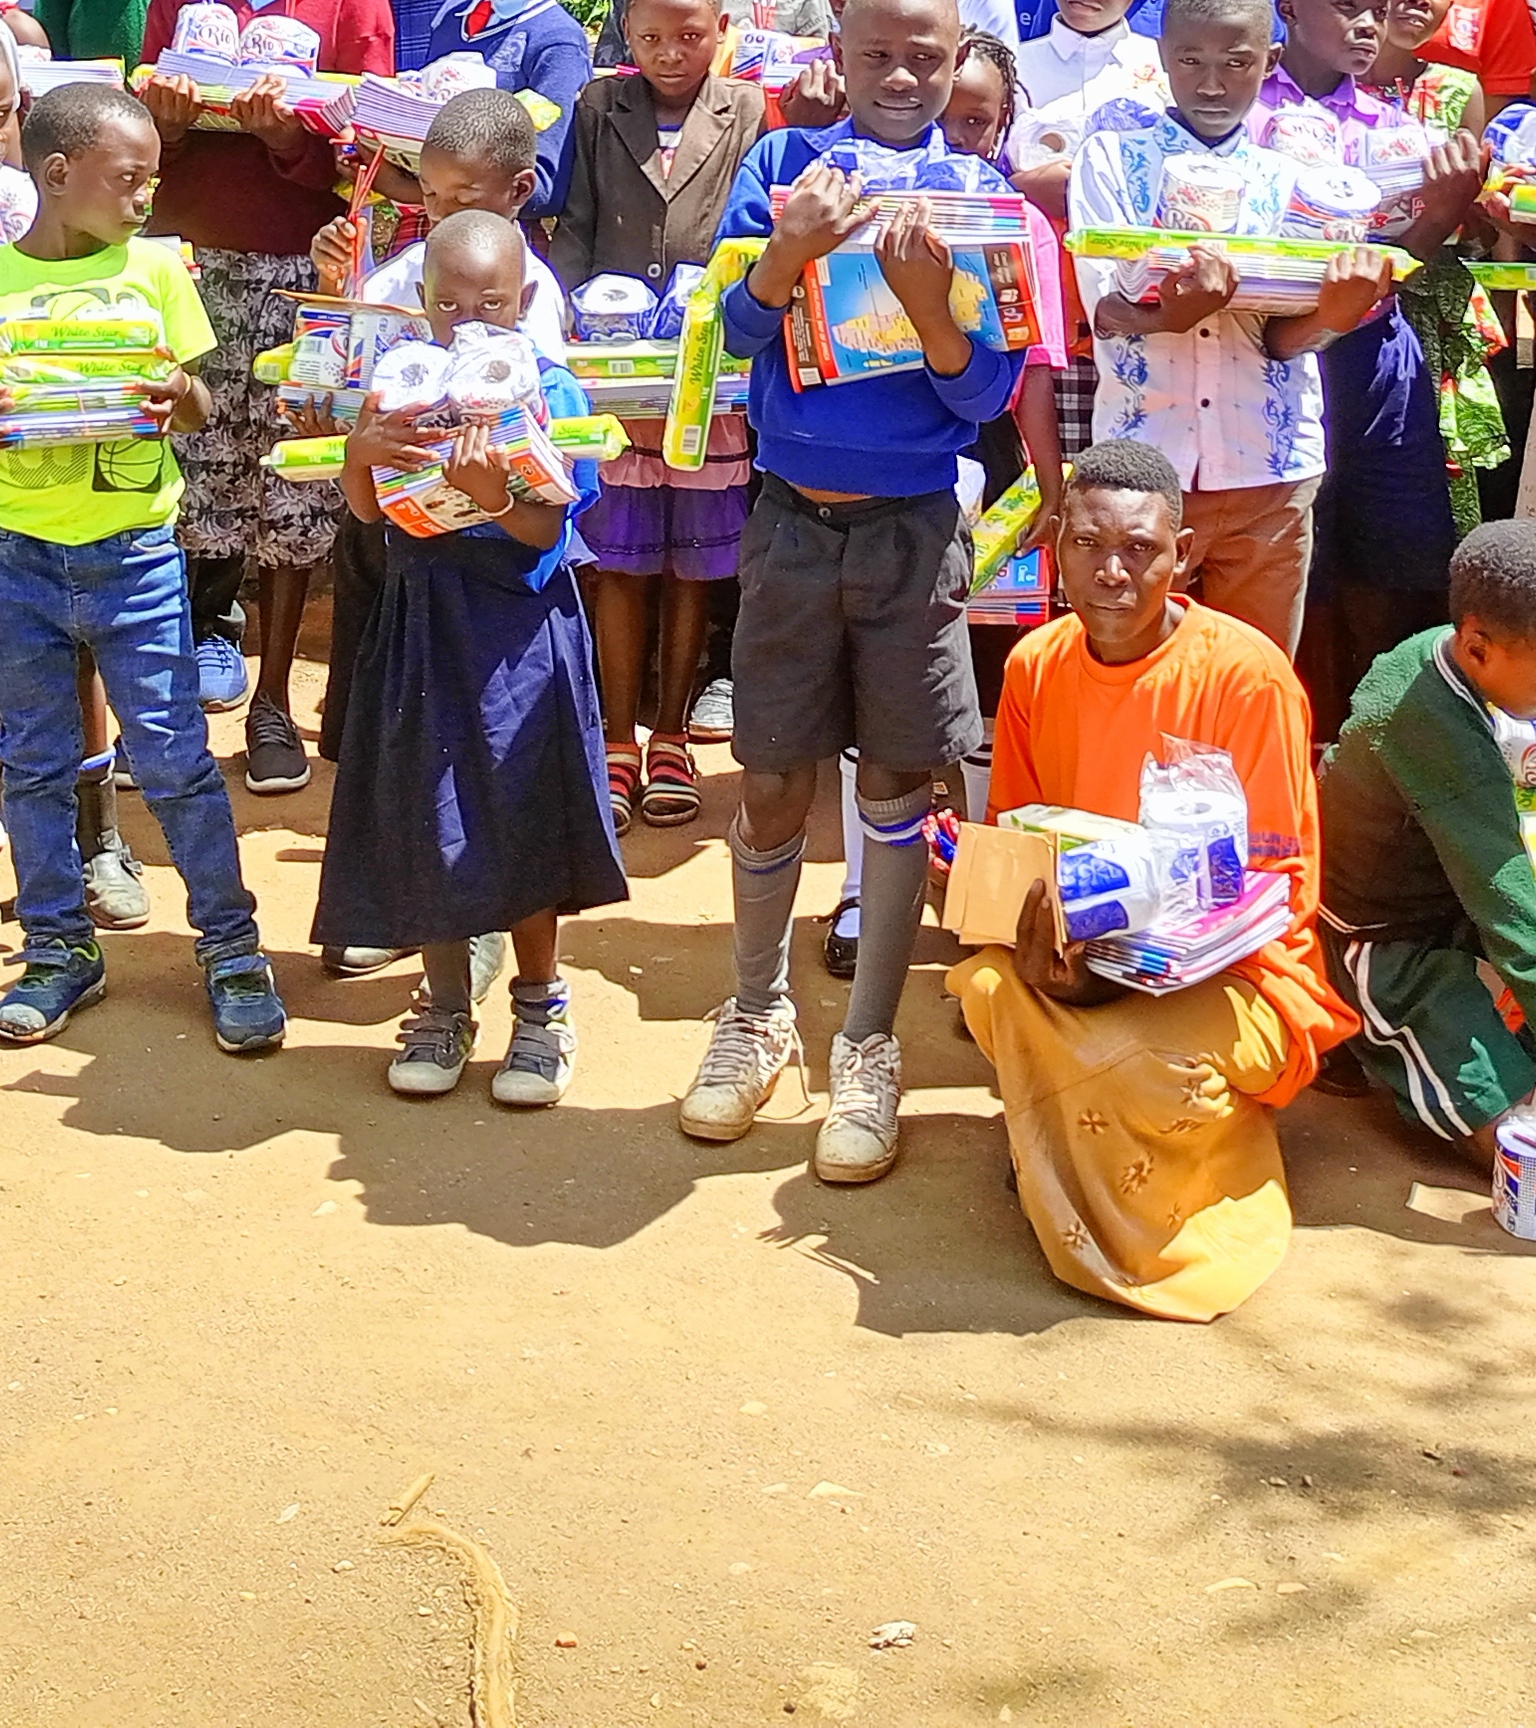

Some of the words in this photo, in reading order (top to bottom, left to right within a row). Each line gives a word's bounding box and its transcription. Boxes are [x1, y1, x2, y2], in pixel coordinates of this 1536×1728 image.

[52, 325, 89, 337] White
[93, 326, 119, 337] Star
[77, 361, 115, 373] White
[689, 346, 706, 385] White
